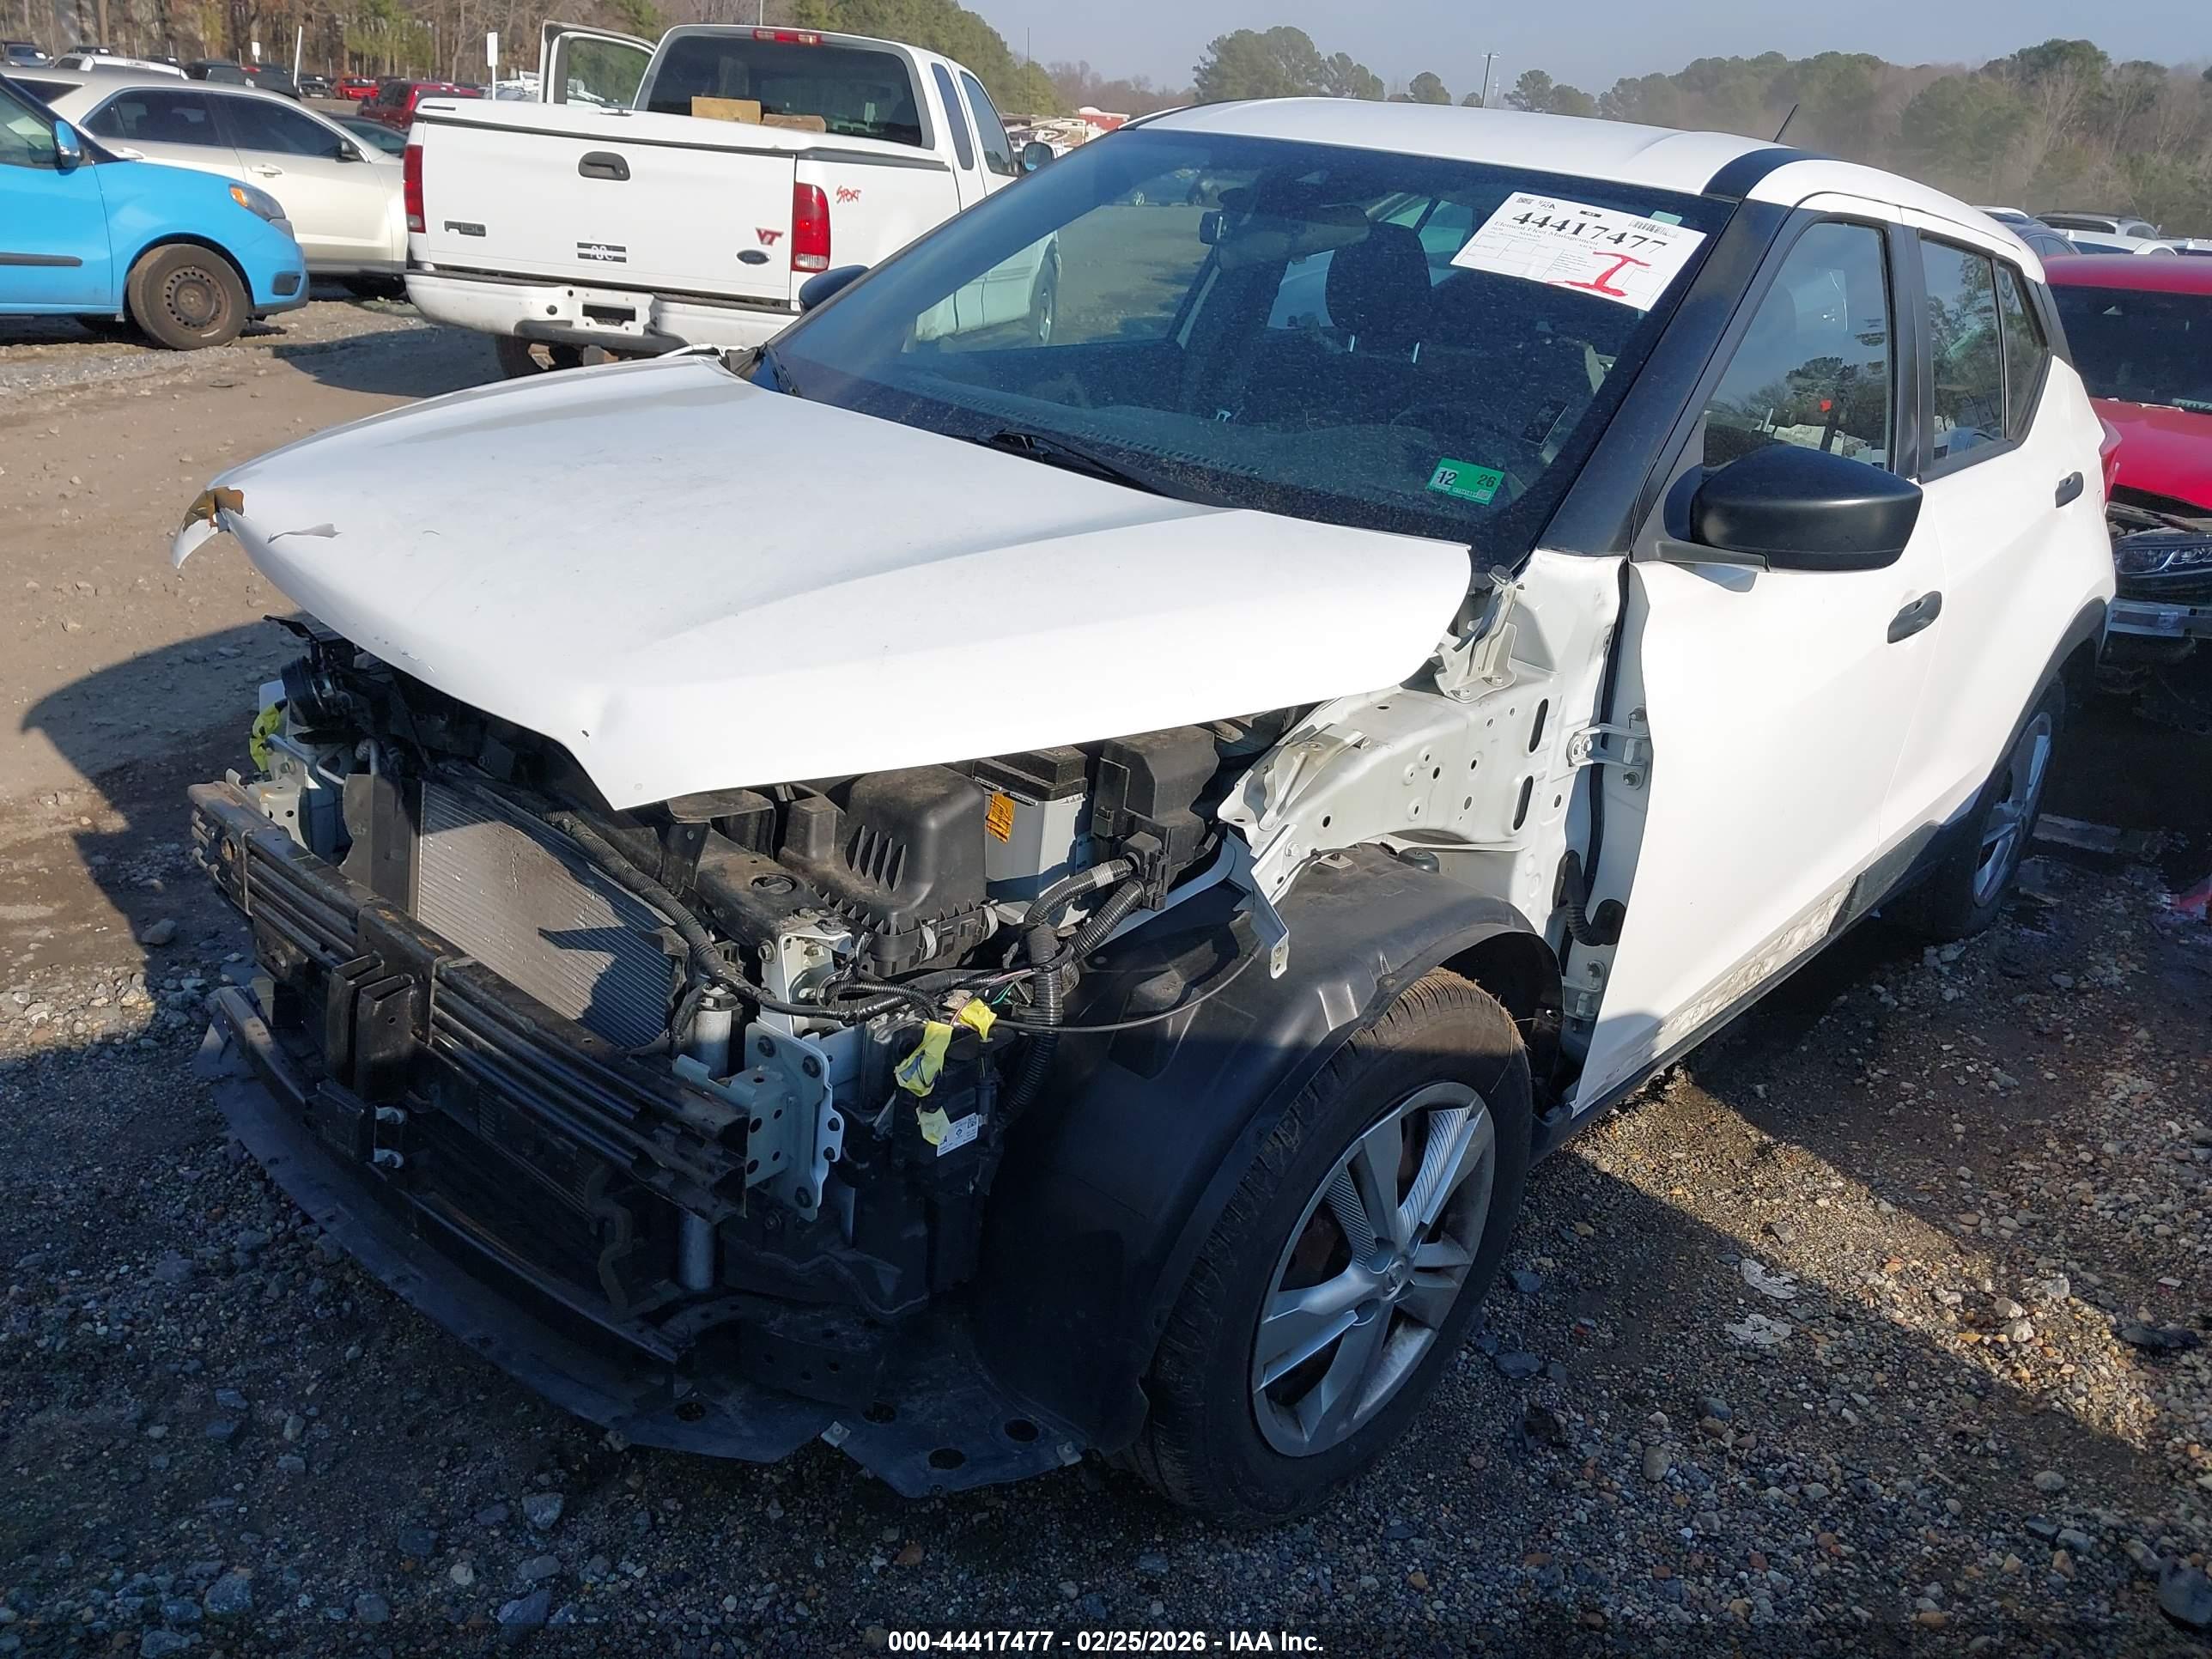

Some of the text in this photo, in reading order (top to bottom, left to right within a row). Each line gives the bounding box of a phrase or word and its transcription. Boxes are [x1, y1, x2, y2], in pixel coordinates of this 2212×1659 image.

[755, 227, 783, 246] VT
[1512, 212, 1668, 253] 44417477
[1438, 470, 1497, 488] 12 26
